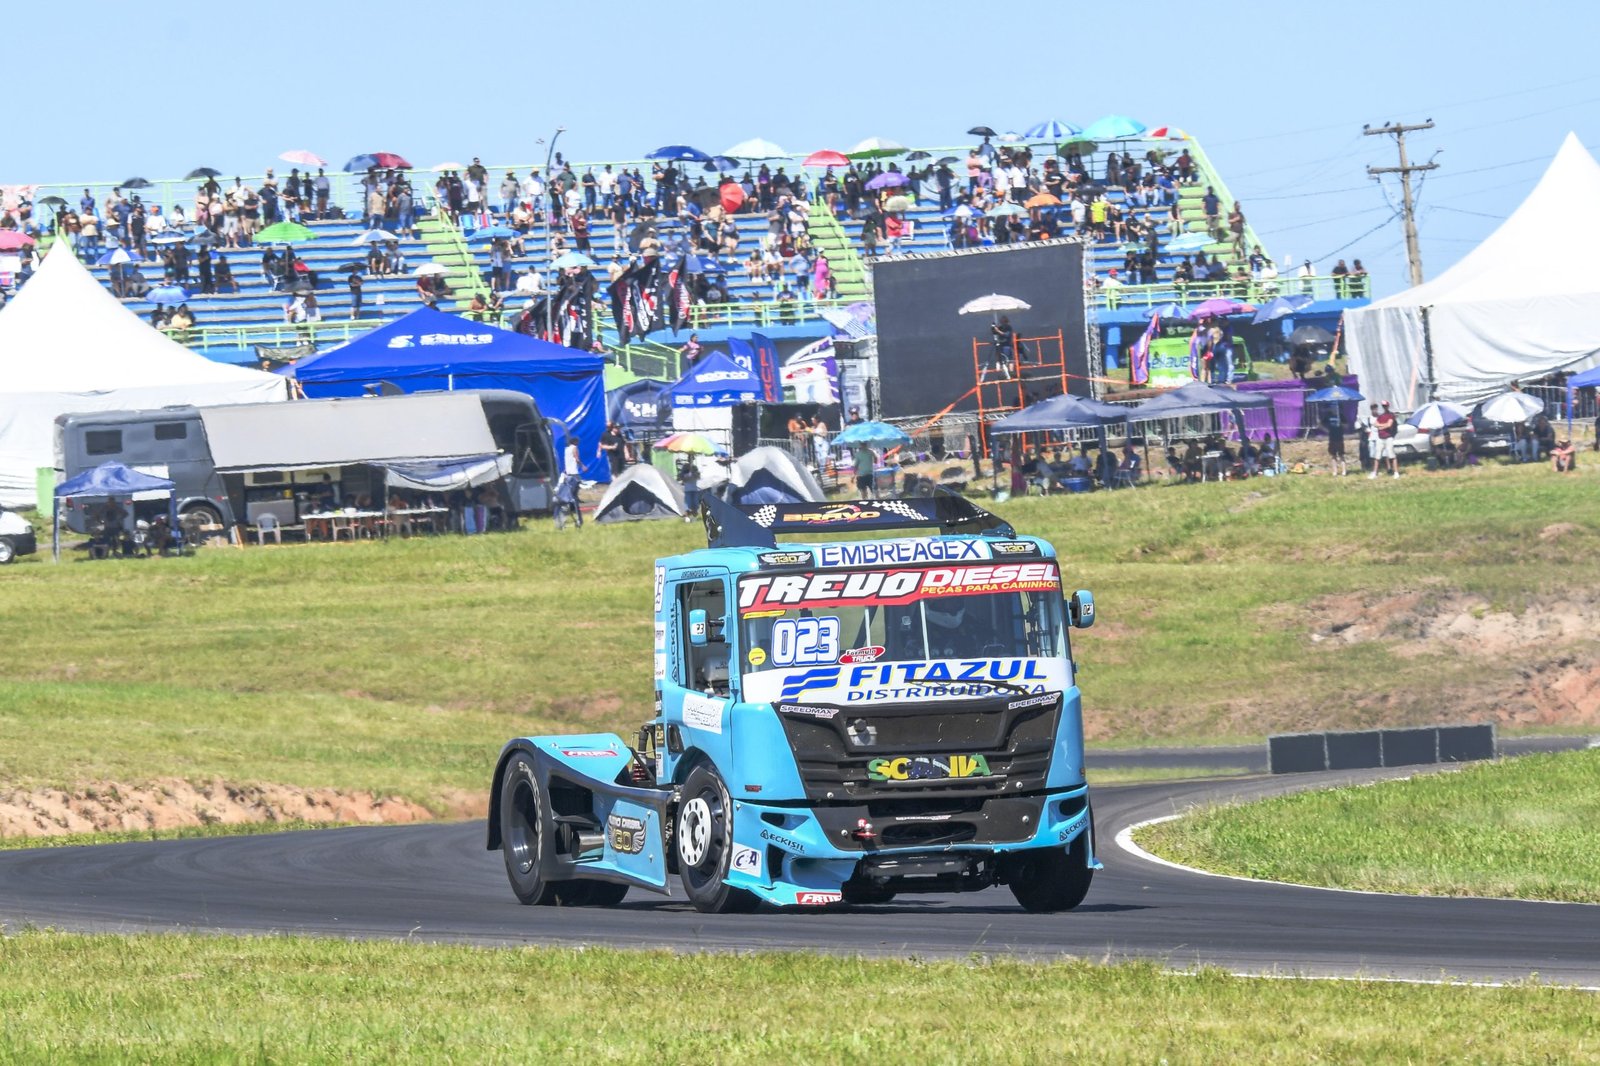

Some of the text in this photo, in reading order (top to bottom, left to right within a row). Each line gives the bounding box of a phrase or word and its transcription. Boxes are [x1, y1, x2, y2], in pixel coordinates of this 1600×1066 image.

[783, 510, 881, 522] BRAVO
[821, 540, 982, 566] EMBREAGEX
[920, 563, 1060, 588] DIESEL
[920, 585, 963, 595] PEÇAS
[965, 583, 999, 592] PARA
[771, 616, 840, 667] 023
[852, 655, 877, 663] TRUCK
[849, 659, 1048, 687] FITAZUL
[847, 684, 1047, 701] DISTRIBUIDORA
[780, 705, 833, 715] SPEEDMAX
[1009, 695, 1056, 709] SPEEDMAX
[868, 754, 992, 781] SCANIA
[769, 834, 805, 852] ECKISIL
